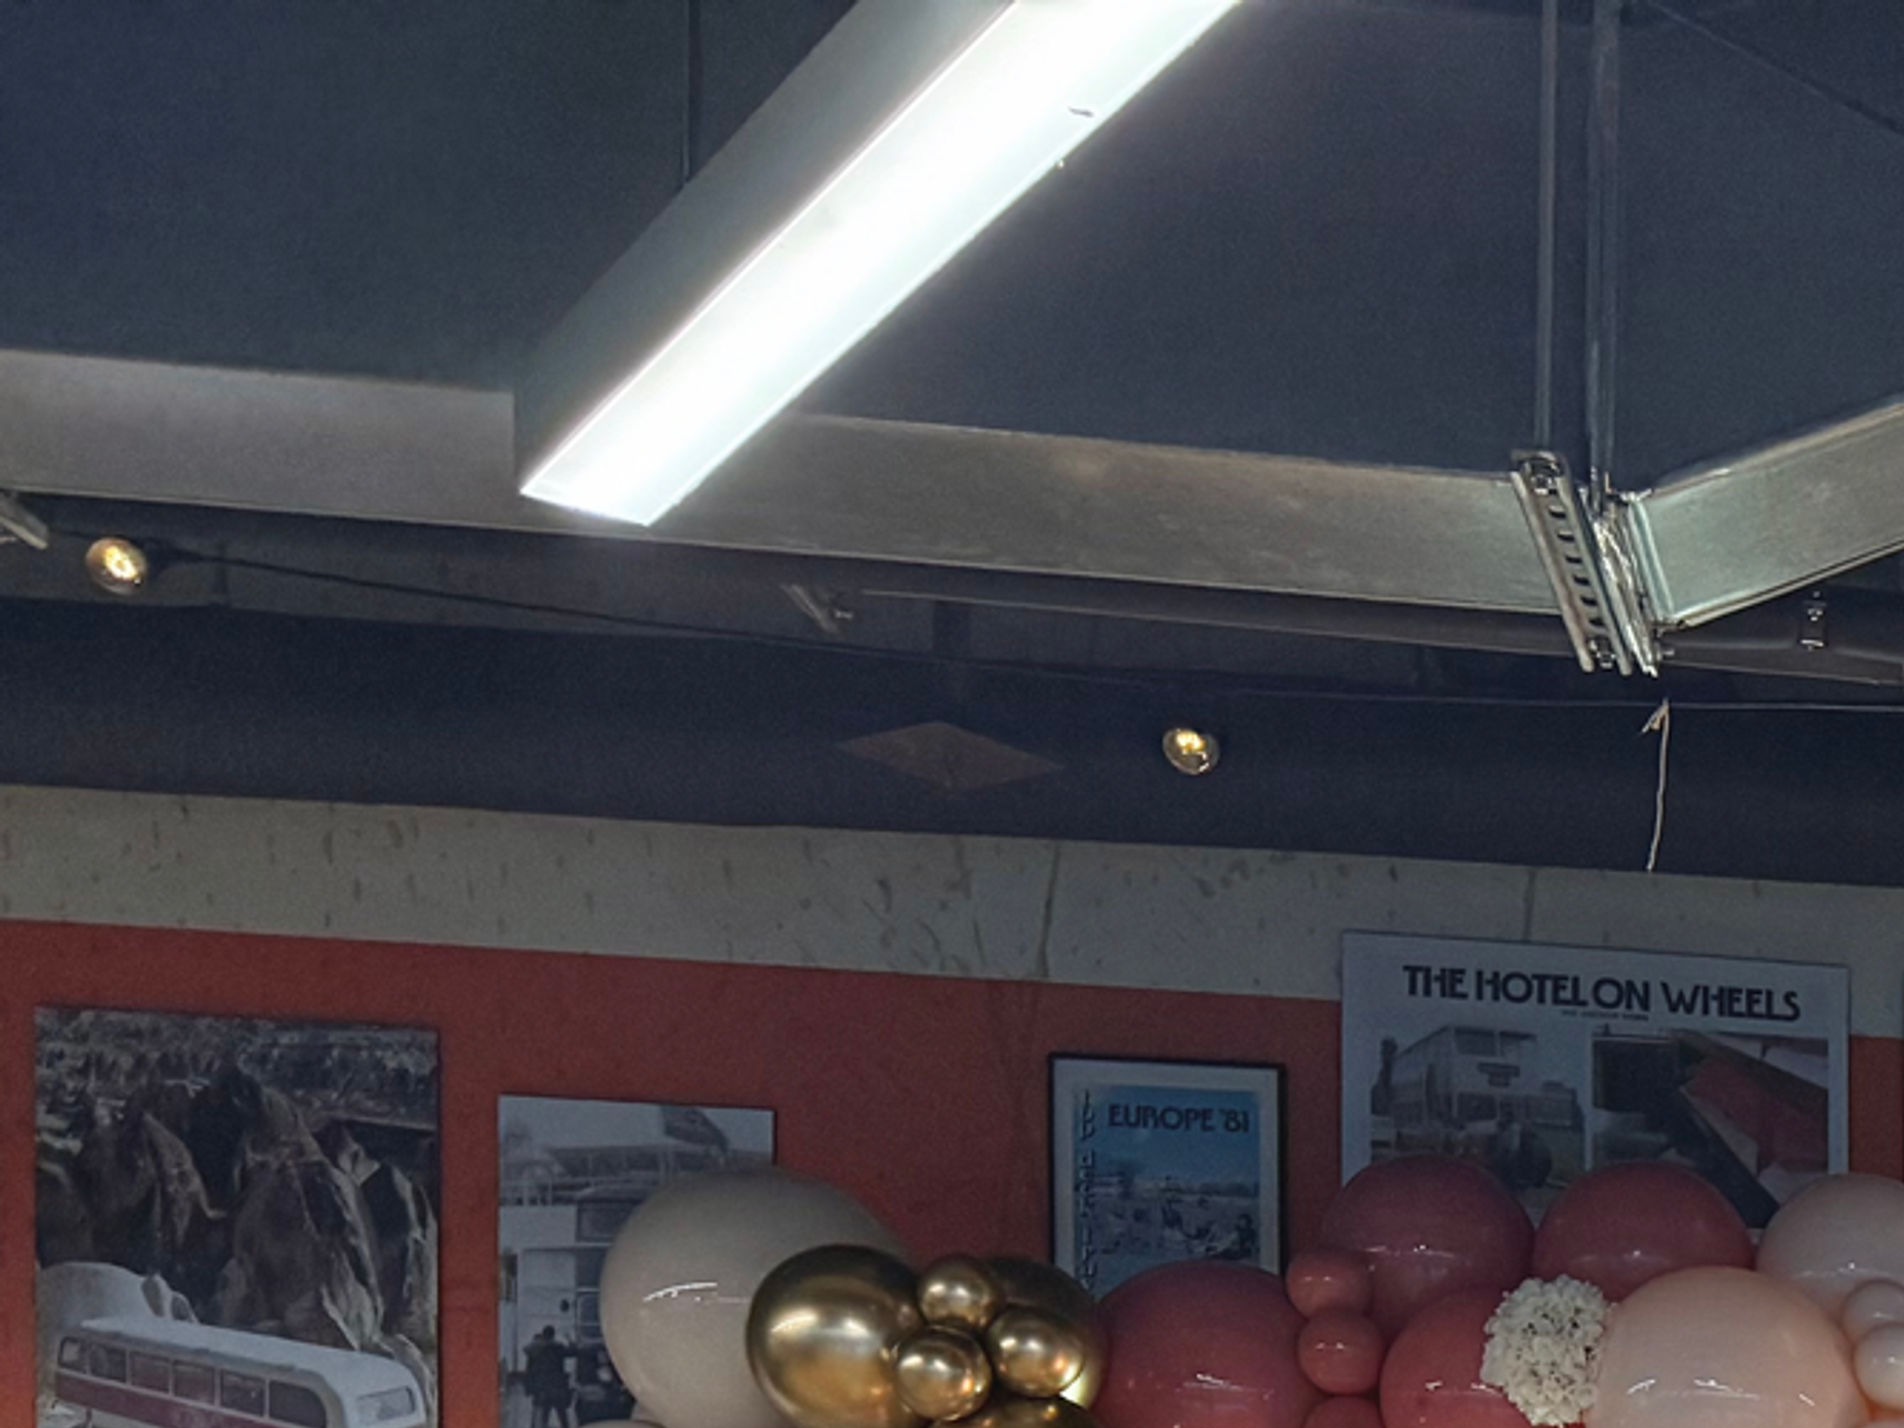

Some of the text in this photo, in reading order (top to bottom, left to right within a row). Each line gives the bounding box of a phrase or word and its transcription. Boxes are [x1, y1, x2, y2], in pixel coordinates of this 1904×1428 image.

[1402, 964, 1801, 1022] THE HOTEL ON WHEELS
[1108, 1102, 1250, 1134] EUROPE '81
